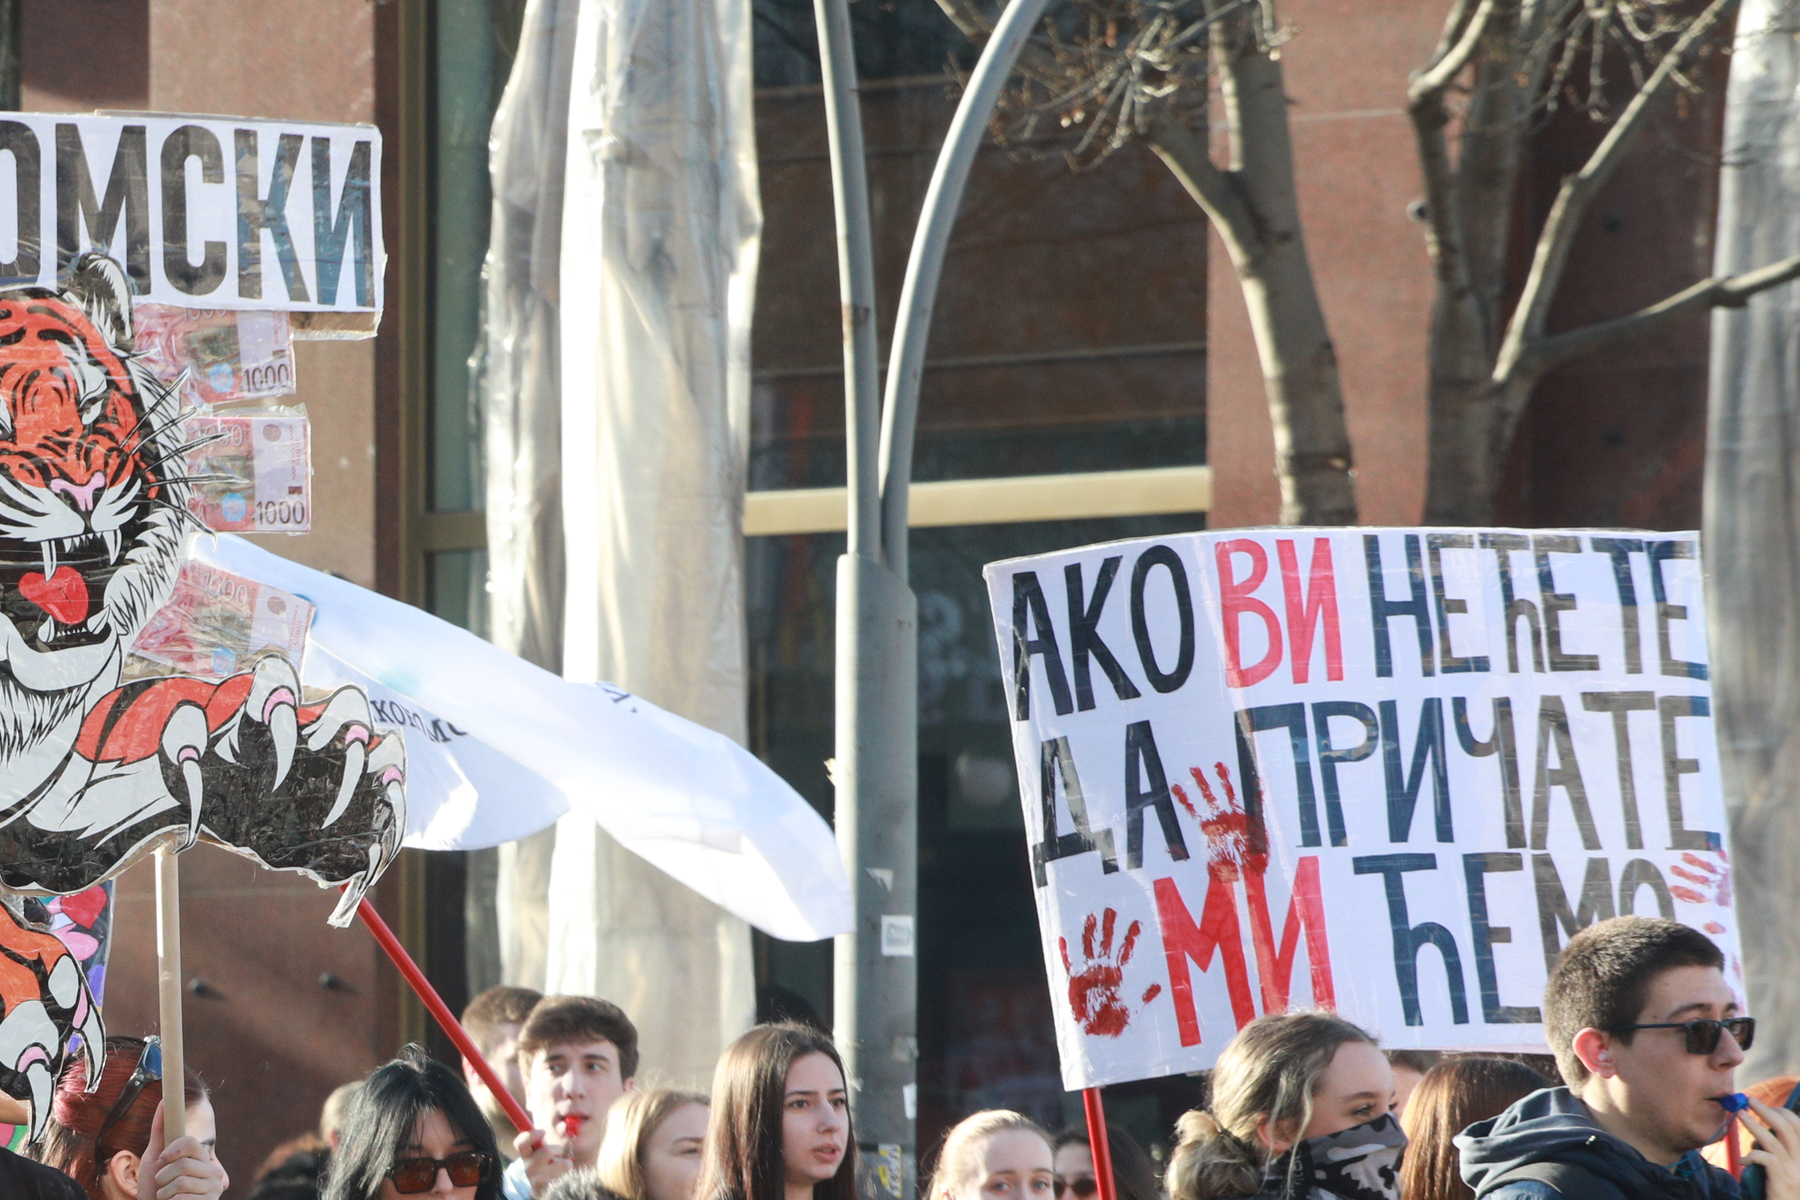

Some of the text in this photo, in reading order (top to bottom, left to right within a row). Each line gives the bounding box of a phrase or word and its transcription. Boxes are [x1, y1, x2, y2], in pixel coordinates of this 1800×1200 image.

[243, 363, 290, 393] 1000
[256, 500, 305, 525] 1000
[202, 571, 249, 607] 1000
[1011, 532, 1708, 721] АКО ВИ НЕЋЕТЕ
[1032, 690, 1720, 887] ДА ПРИЧАТЕ
[1153, 855, 1336, 1048] МИ
